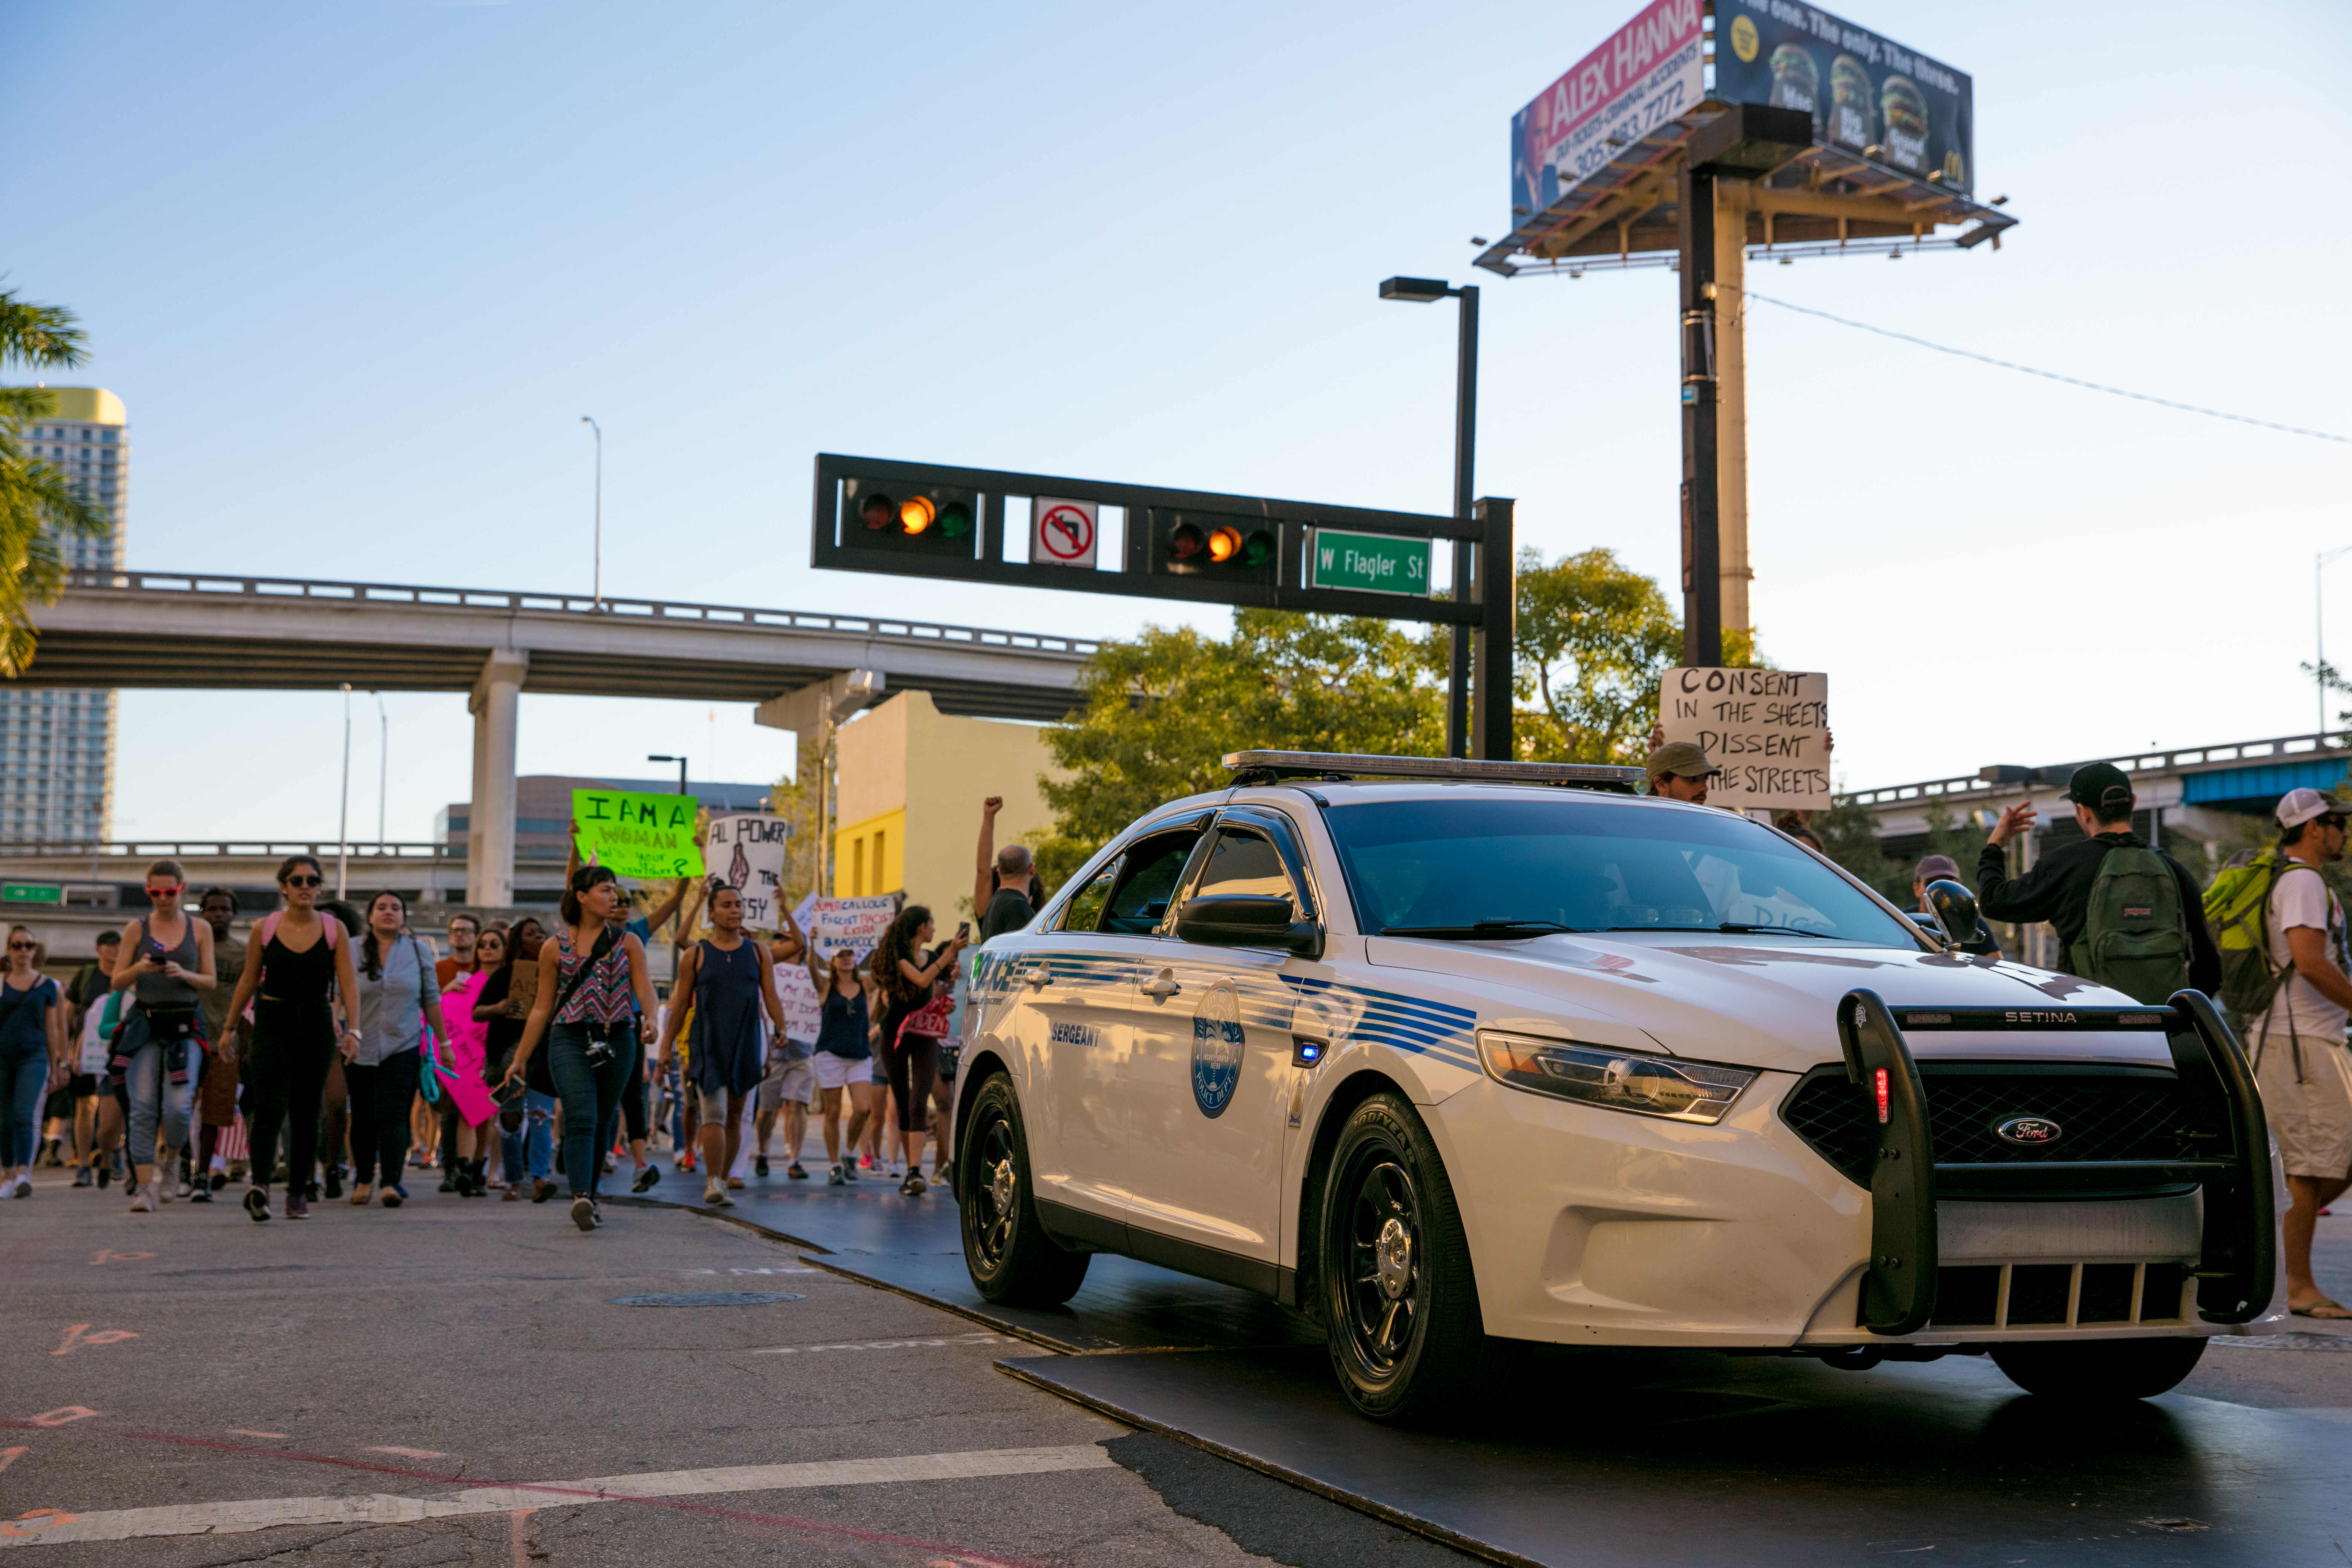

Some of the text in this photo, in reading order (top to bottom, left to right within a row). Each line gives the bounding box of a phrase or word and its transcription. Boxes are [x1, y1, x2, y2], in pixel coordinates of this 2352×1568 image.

[1808, 8, 1841, 45] The
[1841, 28, 1882, 64] only.
[1882, 41, 1913, 75] The
[1914, 55, 1959, 96] three.
[1550, 0, 1698, 138] ALEX HANNA
[1840, 106, 1863, 130] Big
[1840, 127, 1866, 149] Mac
[1889, 128, 1924, 156] Grand
[1320, 547, 1424, 582] W Flagler St
[1681, 669, 1807, 697] CONSENT
[1676, 698, 1828, 728] IN THE SHEETS
[1696, 731, 1811, 757] DISSENT
[1710, 764, 1830, 794] THE STREETS
[586, 796, 611, 820] I
[668, 805, 687, 829] A
[598, 825, 678, 849] WOMAN
[737, 818, 784, 845] POWER
[843, 924, 875, 936] EXTRA
[1203, 993, 1240, 1045] CITY OF MIAMI
[2005, 1012, 2077, 1023] SETINA
[1052, 1022, 1101, 1048] SERGEANT
[1196, 1071, 1233, 1104] POLICE DEPT.
[2015, 1123, 2049, 1139] Ford
